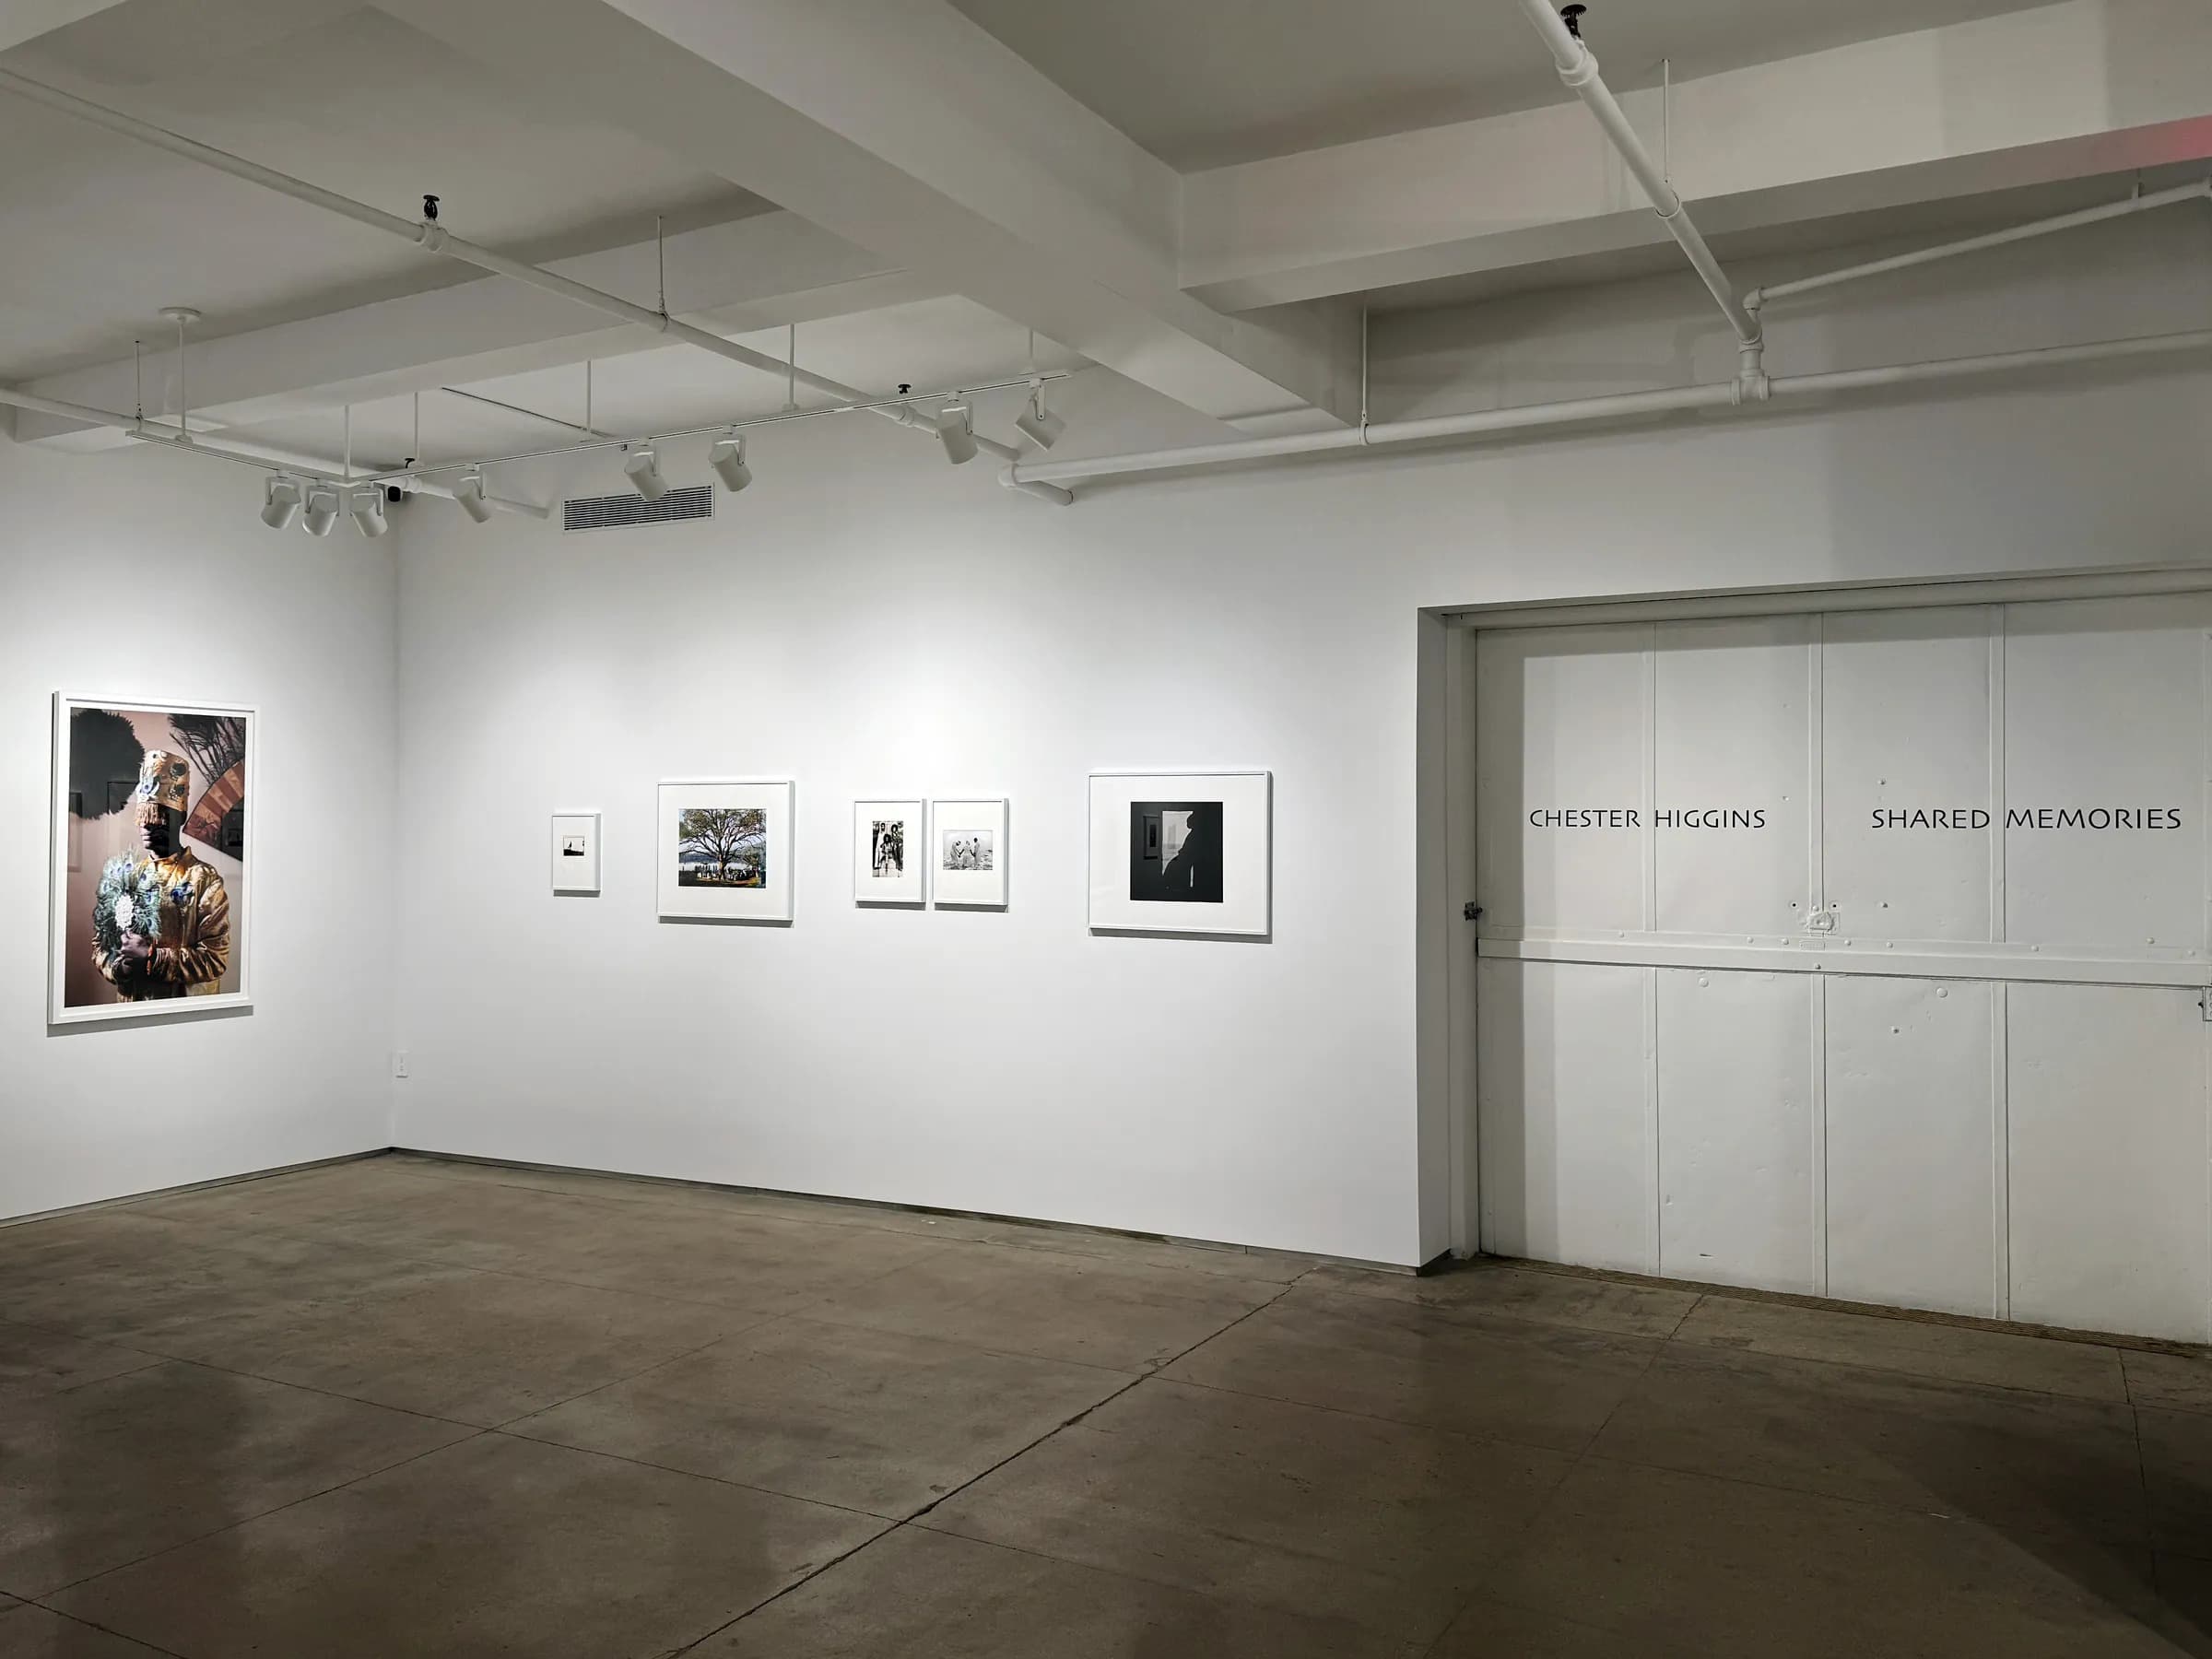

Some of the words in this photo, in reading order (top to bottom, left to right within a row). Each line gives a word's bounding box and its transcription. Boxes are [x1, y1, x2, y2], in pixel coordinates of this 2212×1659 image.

[1529, 808, 1641, 829] CHESTER
[1654, 808, 1766, 830] HIGGINS
[1871, 808, 1991, 830] SHARED
[2006, 808, 2183, 830] MEMORIES
